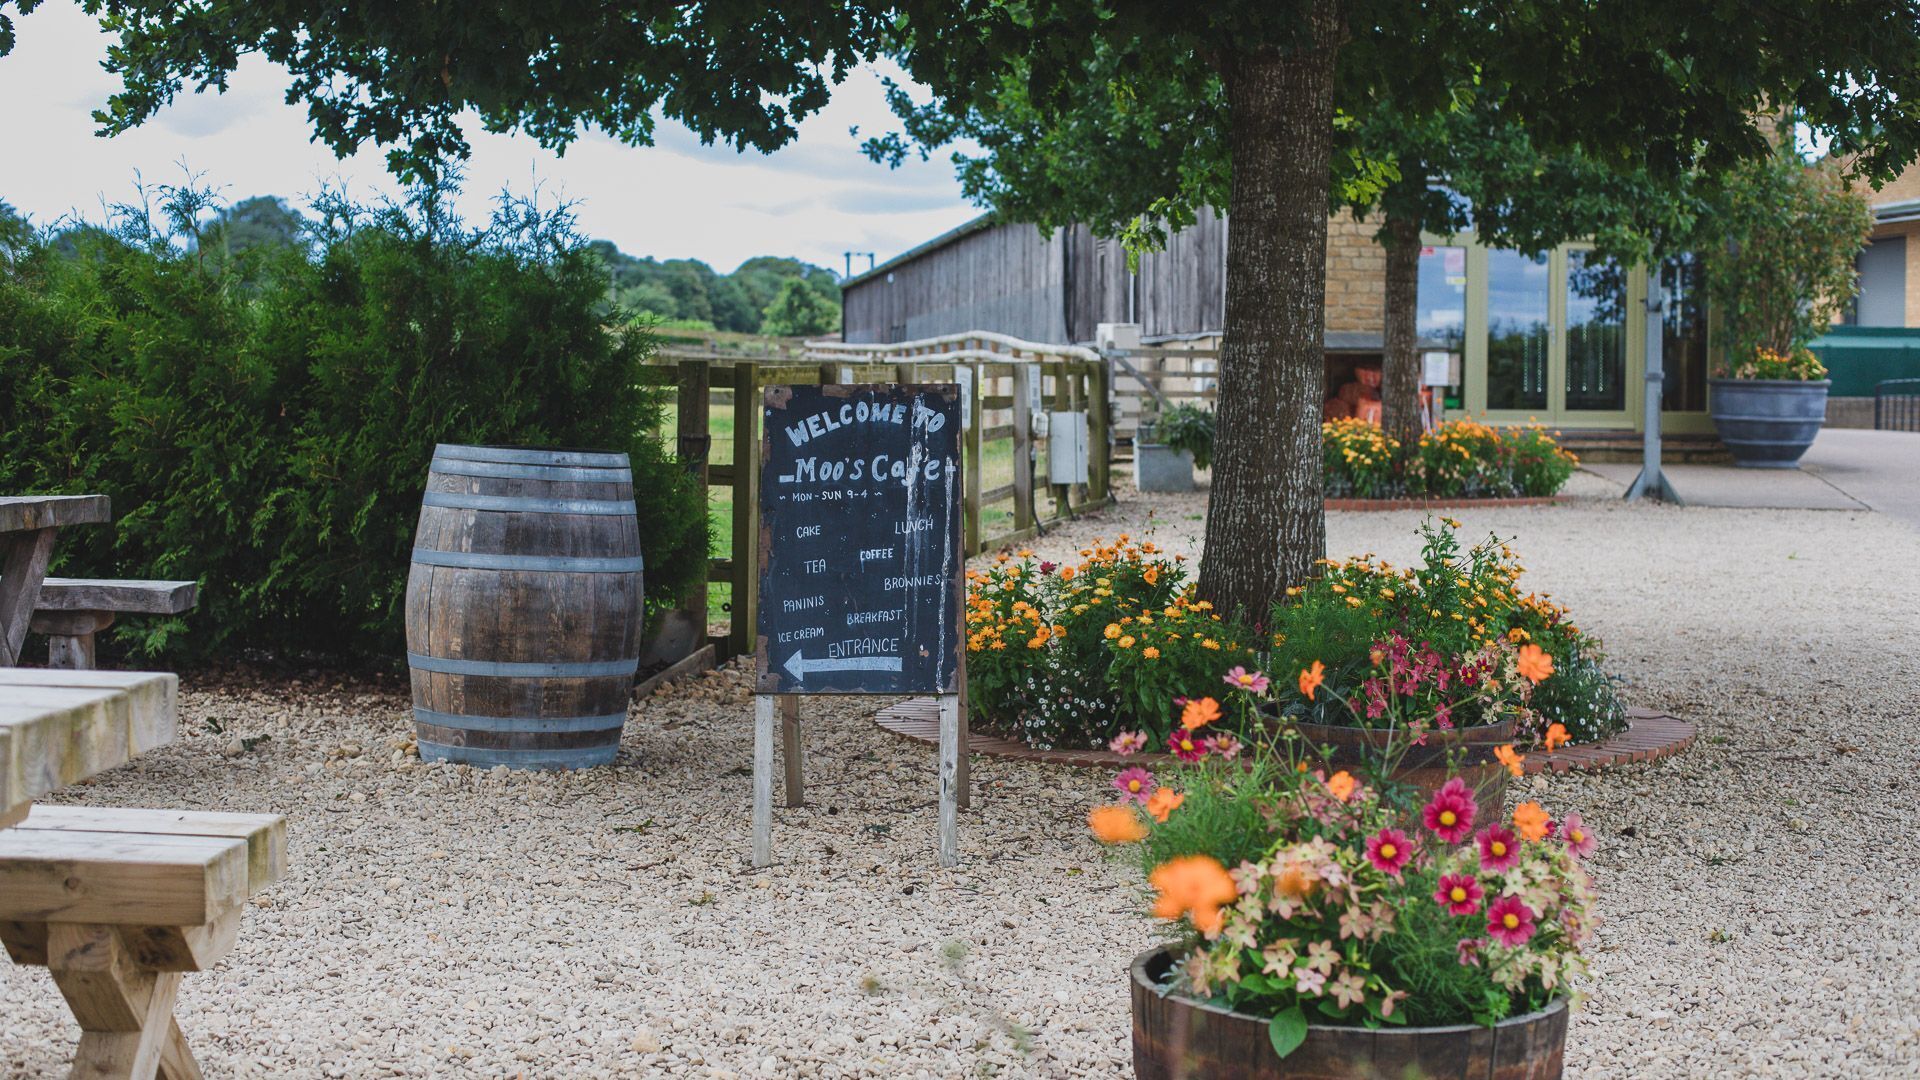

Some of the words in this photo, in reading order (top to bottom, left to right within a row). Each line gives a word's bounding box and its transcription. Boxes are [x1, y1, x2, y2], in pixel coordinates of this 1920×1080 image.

[785, 402, 907, 447] WELCOME
[914, 406, 946, 433] TO
[847, 489, 868, 499] 9-4
[796, 525, 821, 539] CAKE
[895, 518, 934, 534] LUNCH
[860, 548, 894, 561] COFFEE
[804, 559, 827, 574] TEA
[884, 574, 941, 591] BROWNIES
[783, 595, 825, 613] PANINIS
[846, 609, 903, 625] BREAKFAST
[778, 632, 792, 643] ICE
[793, 627, 825, 640] CREAM
[828, 637, 900, 658] ENTRANCE
